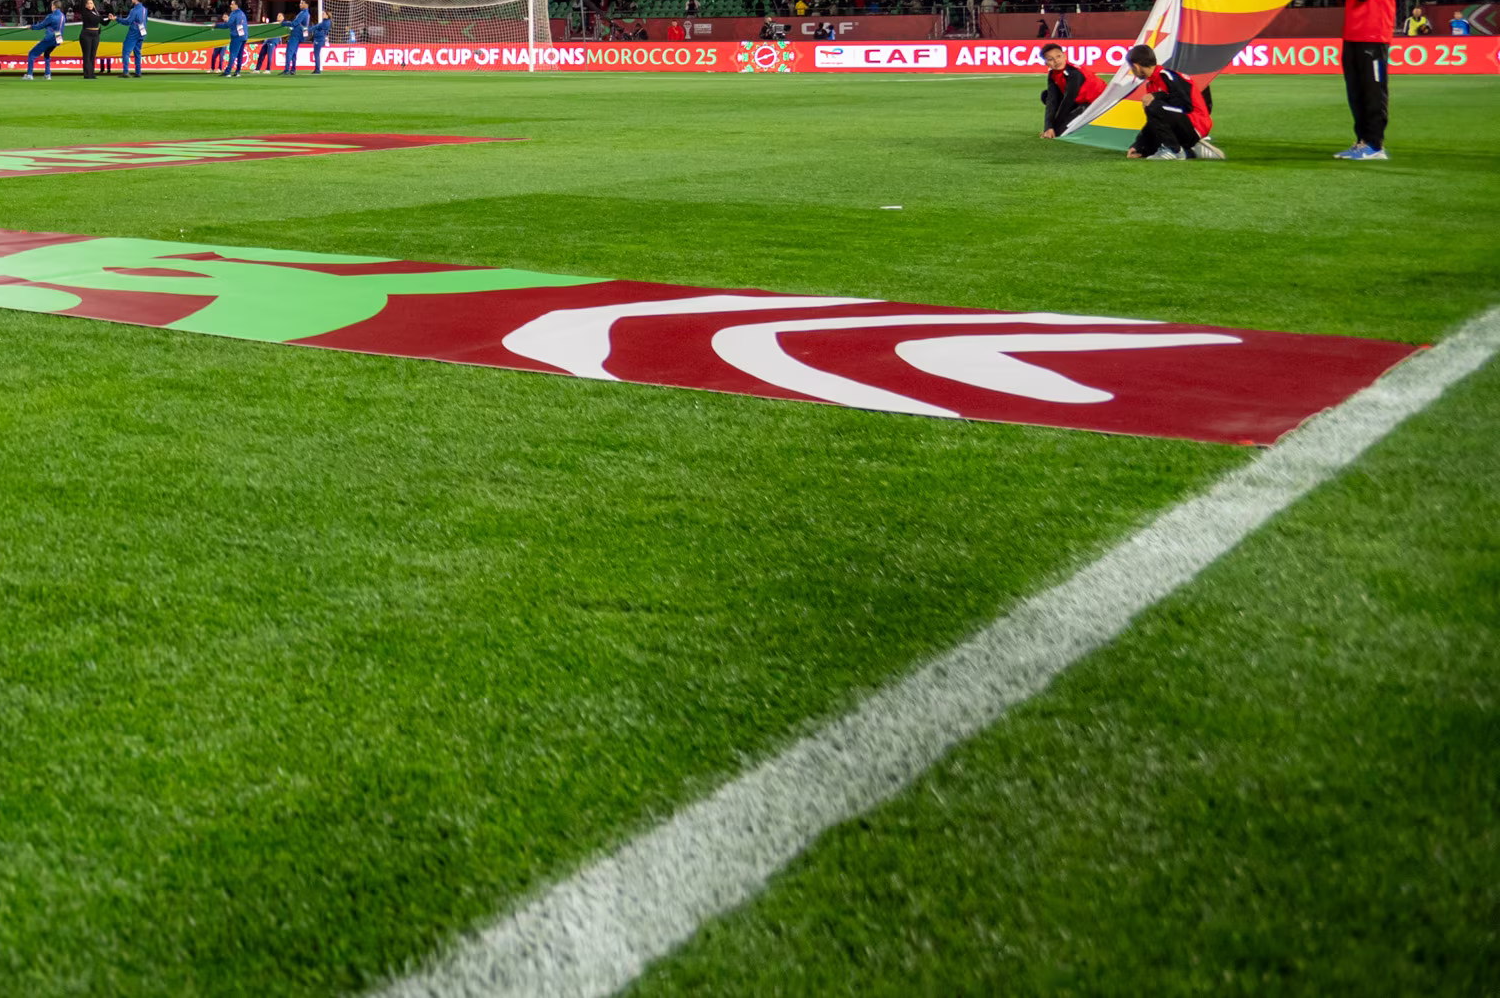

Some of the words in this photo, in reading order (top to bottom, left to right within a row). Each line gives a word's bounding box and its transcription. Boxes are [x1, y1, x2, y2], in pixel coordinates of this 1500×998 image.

[192, 50, 207, 64] 25
[372, 48, 434, 65] AFRICA
[436, 48, 472, 65] CUP
[473, 48, 499, 65] OF
[502, 48, 585, 65] NATIONS
[587, 48, 690, 65] MOROCCO
[695, 48, 717, 65] 25
[864, 49, 930, 64] CAF
[956, 46, 1046, 66] AFRICA
[1064, 46, 1102, 66] UP
[1106, 45, 1132, 66] O
[1272, 45, 1428, 66] MORCO
[1435, 45, 1467, 66] 25
